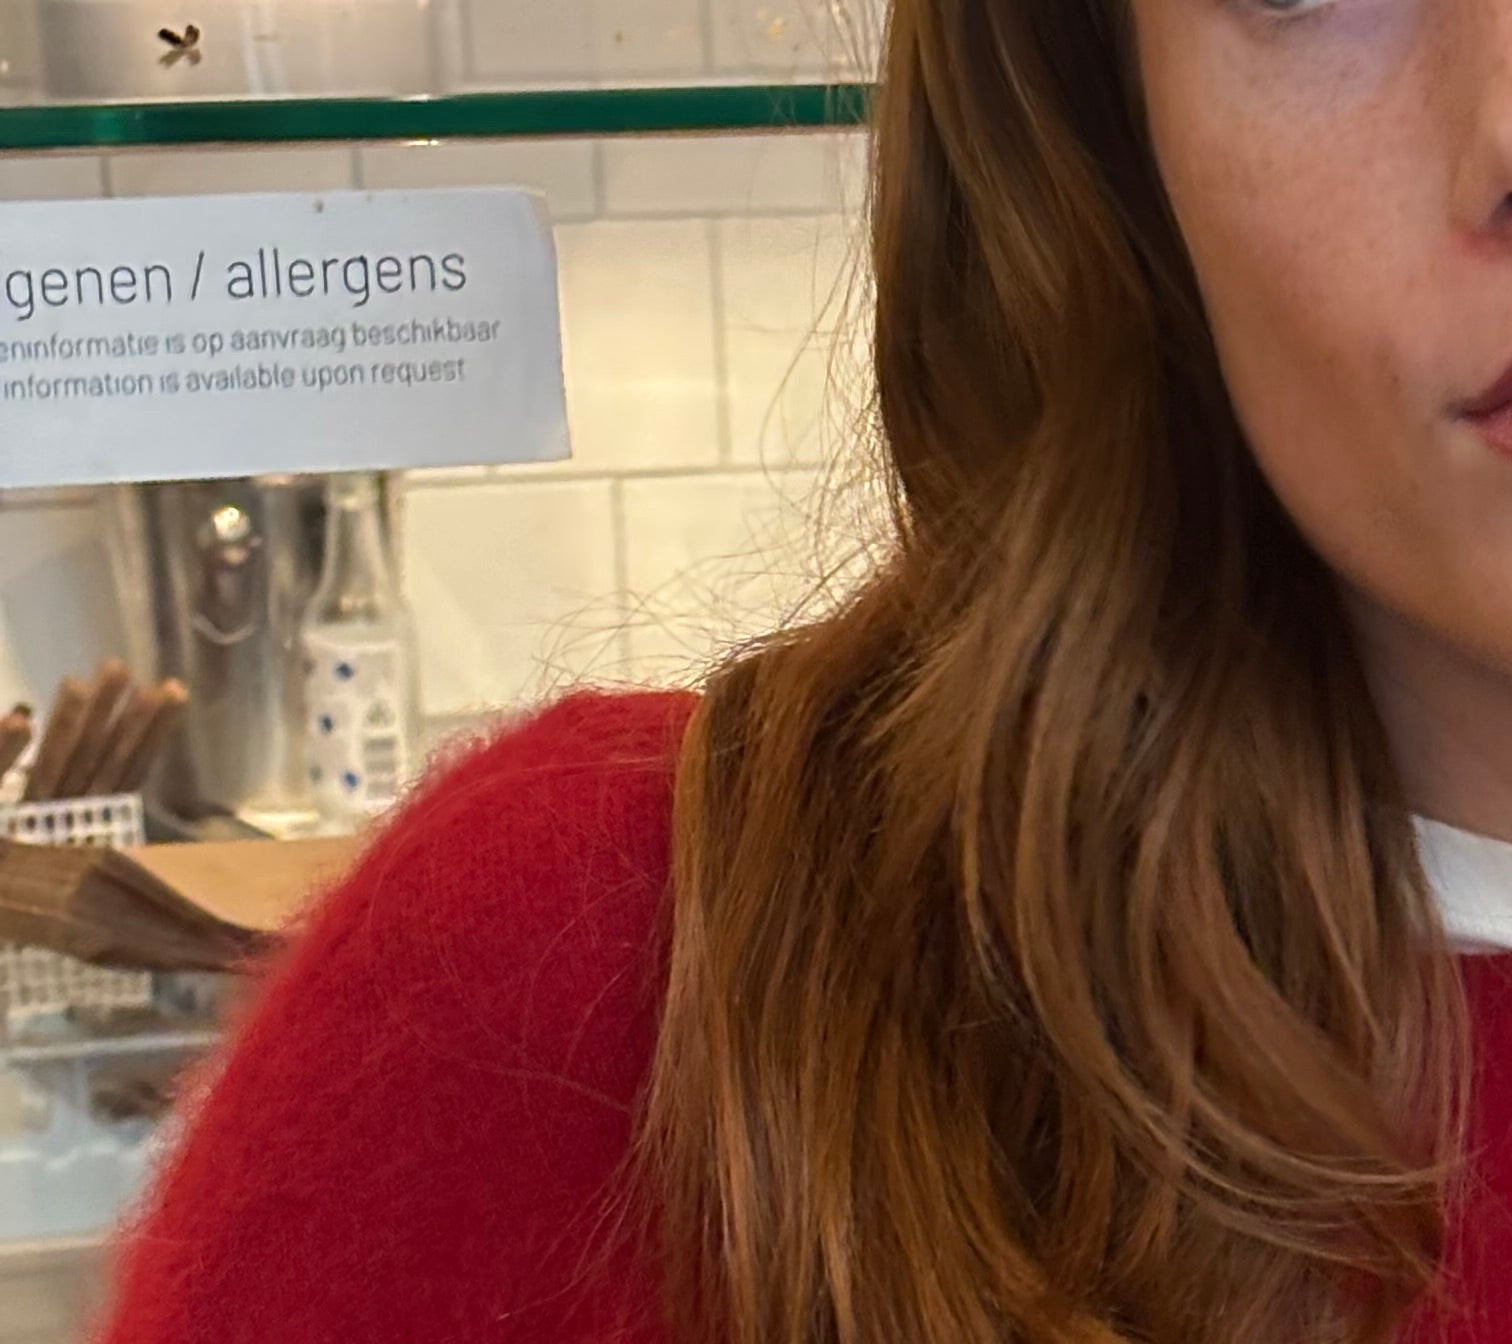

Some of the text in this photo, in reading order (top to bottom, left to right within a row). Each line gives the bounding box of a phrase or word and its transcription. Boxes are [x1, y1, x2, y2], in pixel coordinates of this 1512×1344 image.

[5, 264, 172, 322] genen
[227, 247, 467, 308] allergens
[165, 333, 186, 355] is
[192, 332, 224, 357] op
[230, 325, 345, 353] aanvraag
[351, 316, 501, 346] beschikbaar
[3, 358, 465, 401] information is available upon request
